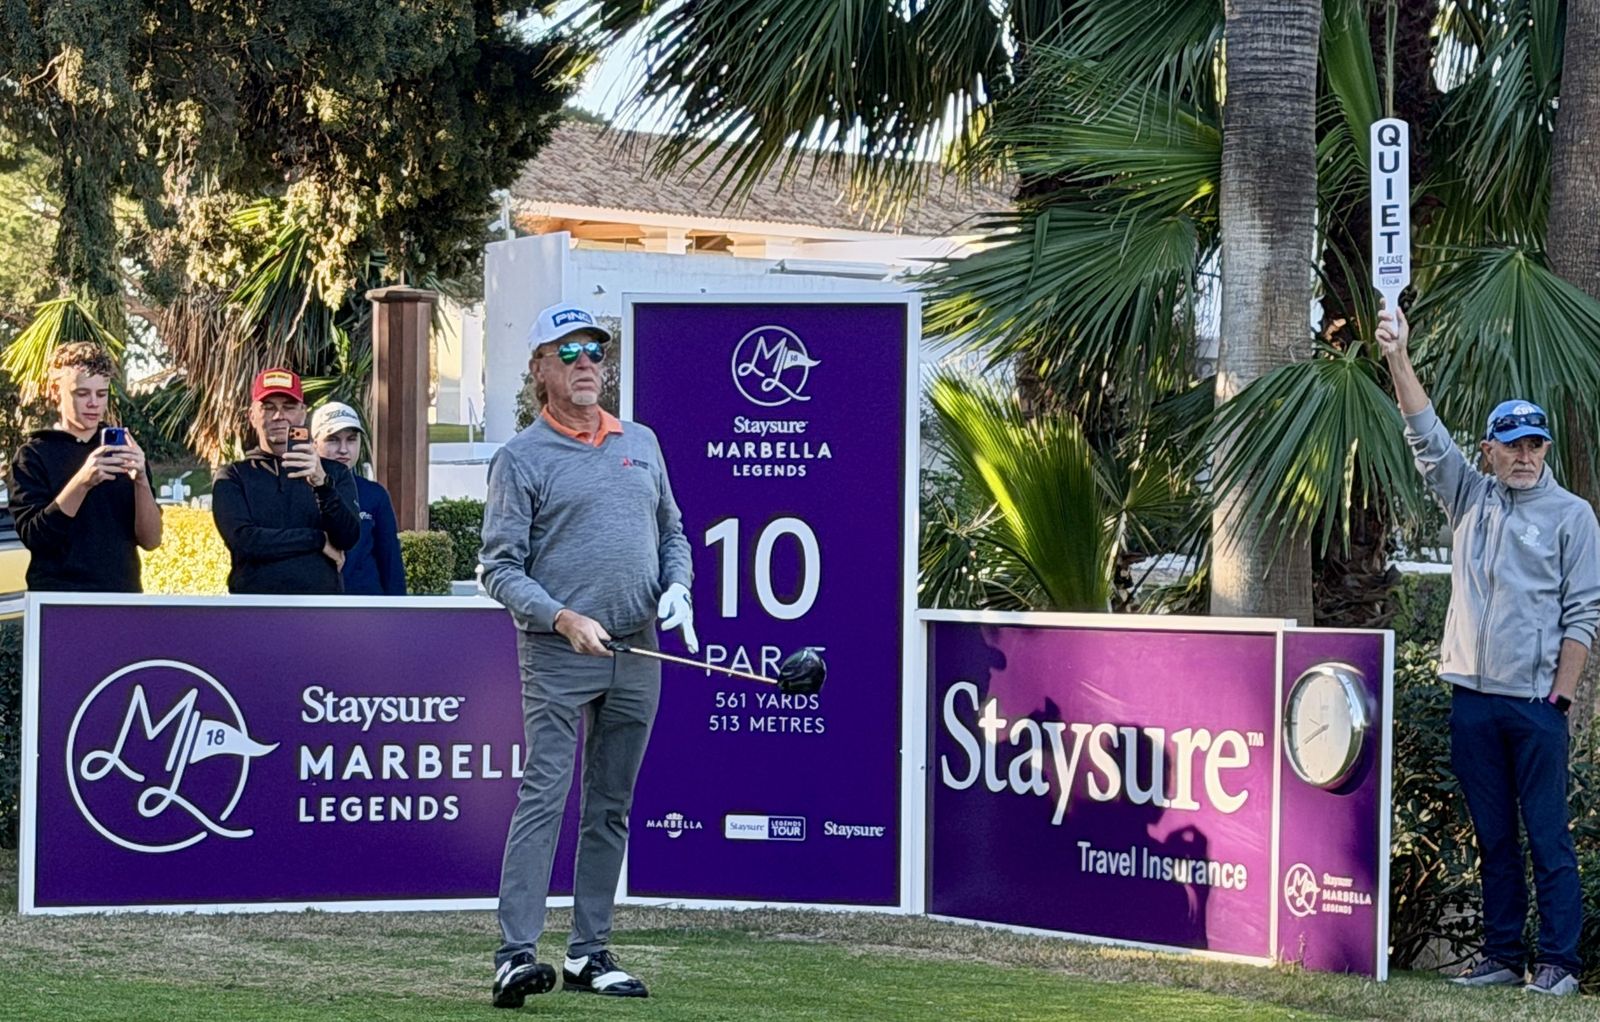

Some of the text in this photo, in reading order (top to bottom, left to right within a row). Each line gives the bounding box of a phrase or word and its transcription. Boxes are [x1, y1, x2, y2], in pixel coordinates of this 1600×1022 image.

[1377, 124, 1402, 254] QUIET
[1378, 255, 1403, 264] PLEASE
[555, 311, 592, 324] PING
[733, 416, 807, 437] Staysure
[707, 441, 832, 459] MARBELLA
[733, 465, 807, 477] LEGENDS
[705, 517, 821, 620] 10
[706, 645, 781, 678] PAR
[302, 686, 460, 731] Staysure
[715, 692, 820, 710] 561 YARDS
[709, 715, 825, 734] 513 METRES
[206, 729, 226, 746] 18
[300, 744, 523, 780] MARBELL
[299, 796, 459, 822] LEGENDS
[646, 819, 703, 829] MARBELLA
[730, 822, 765, 831] Staysure
[772, 827, 801, 836] TOUR
[824, 821, 884, 839] Staysure
[1077, 841, 1248, 890] Travel Insurance
[1322, 889, 1372, 905] MARBELLA
